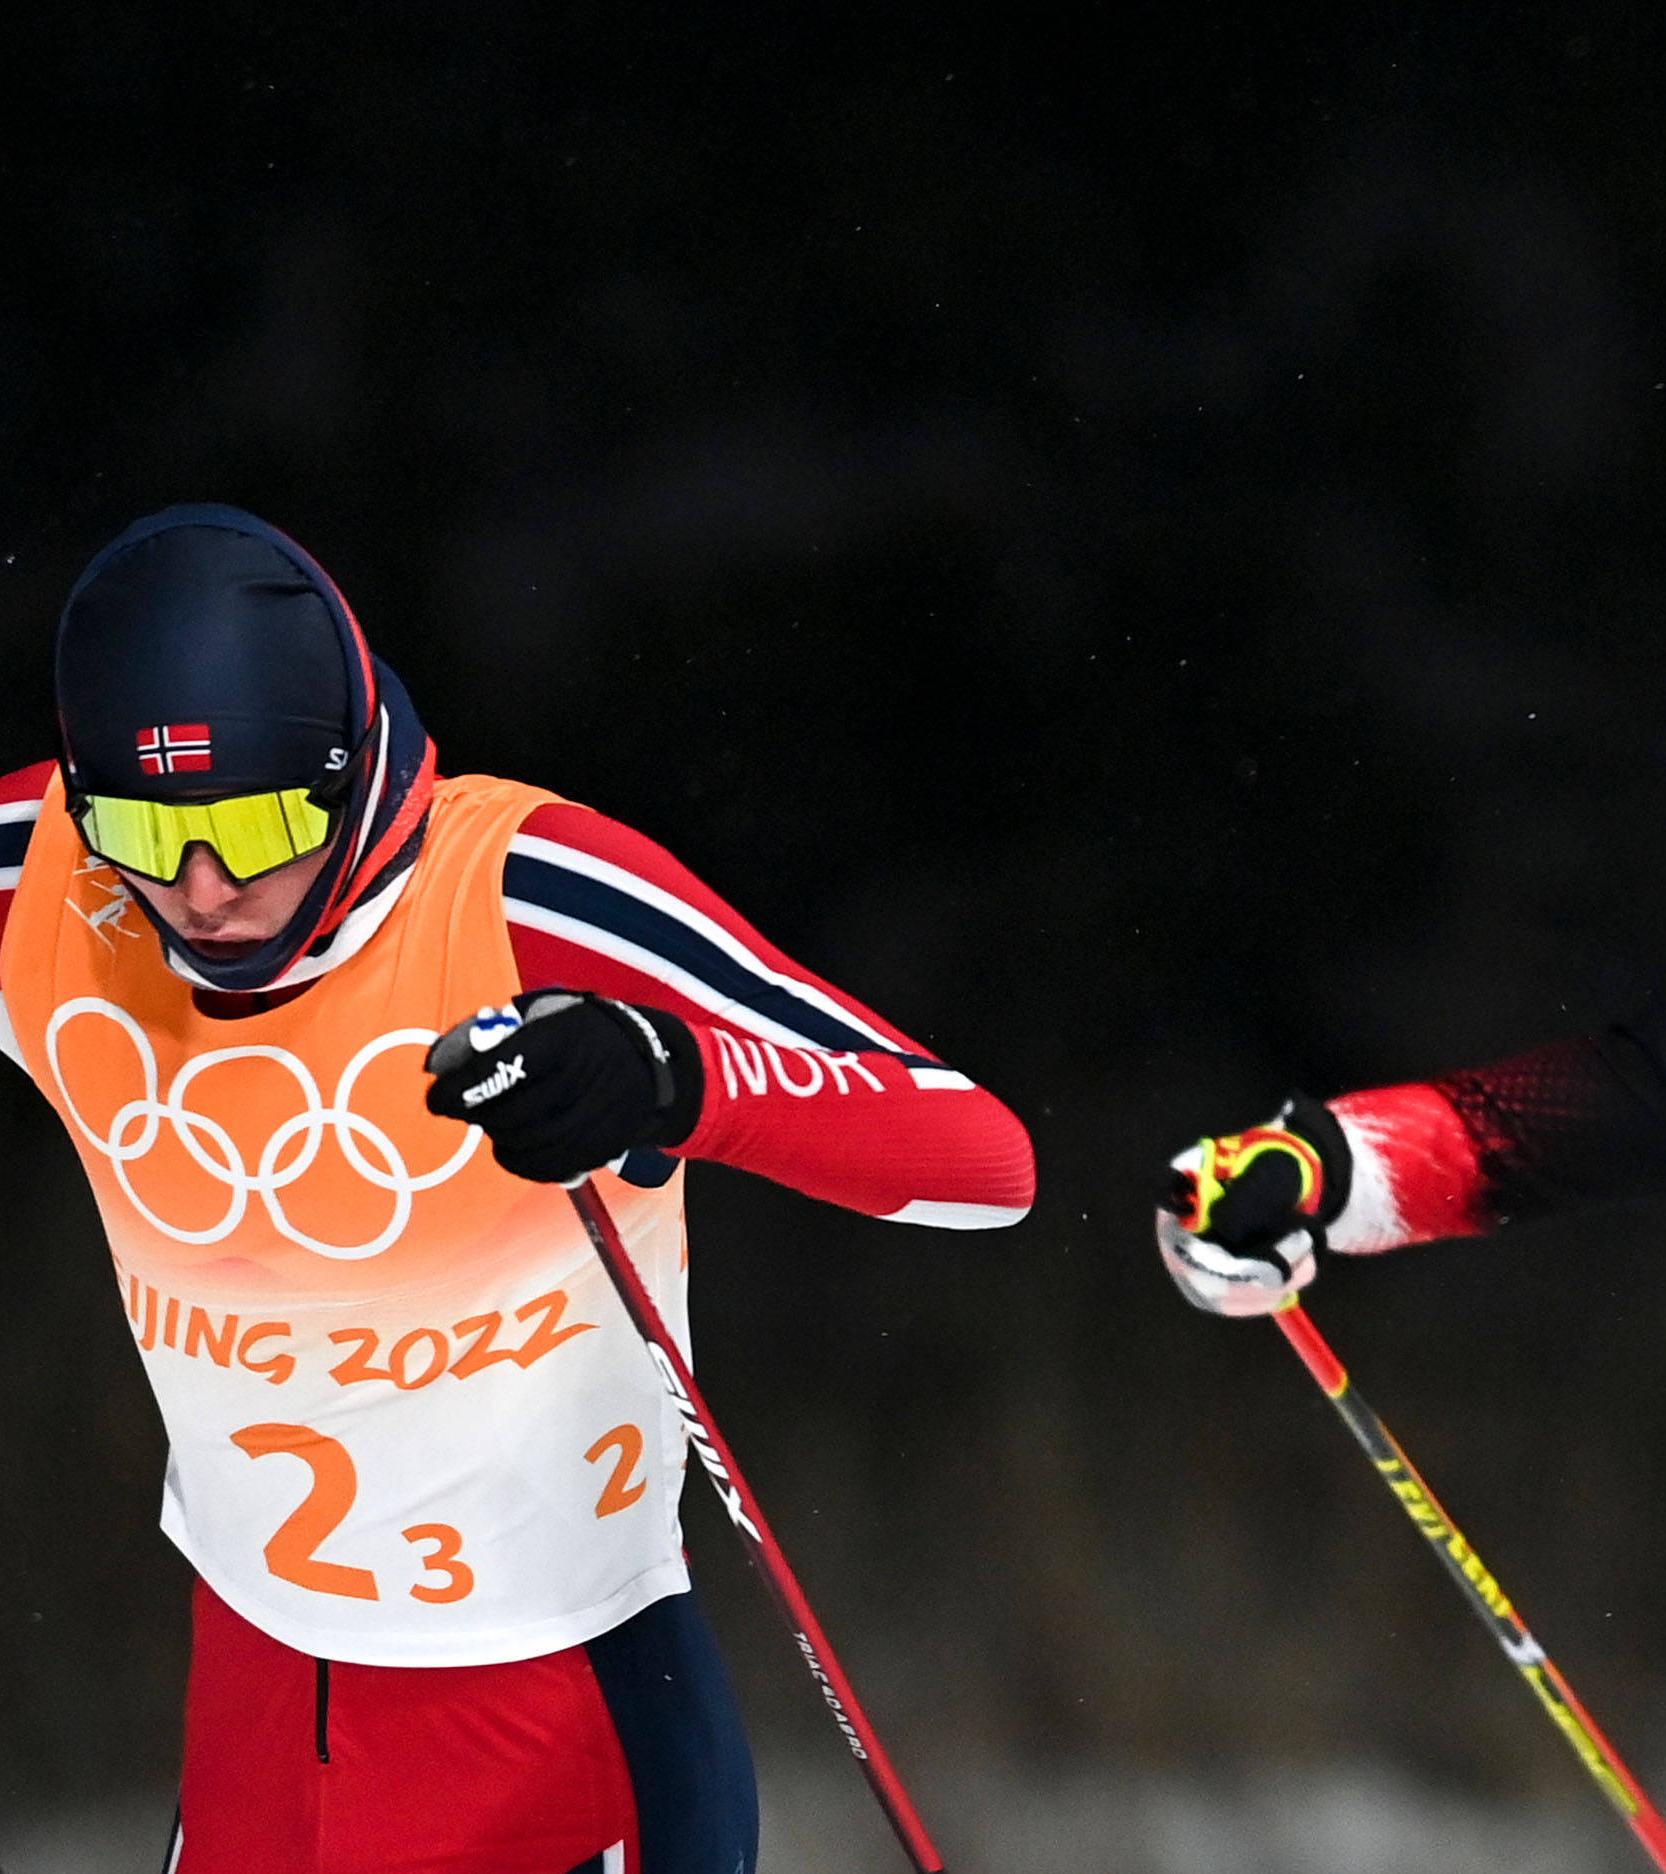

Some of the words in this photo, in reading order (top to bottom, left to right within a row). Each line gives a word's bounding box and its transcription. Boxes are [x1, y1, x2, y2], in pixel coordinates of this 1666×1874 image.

[709, 1026, 887, 1099] NOR
[329, 1290, 596, 1390] 2022
[231, 1422, 379, 1601] 2
[402, 1523, 475, 1604] 3
[583, 1423, 647, 1519] 2
